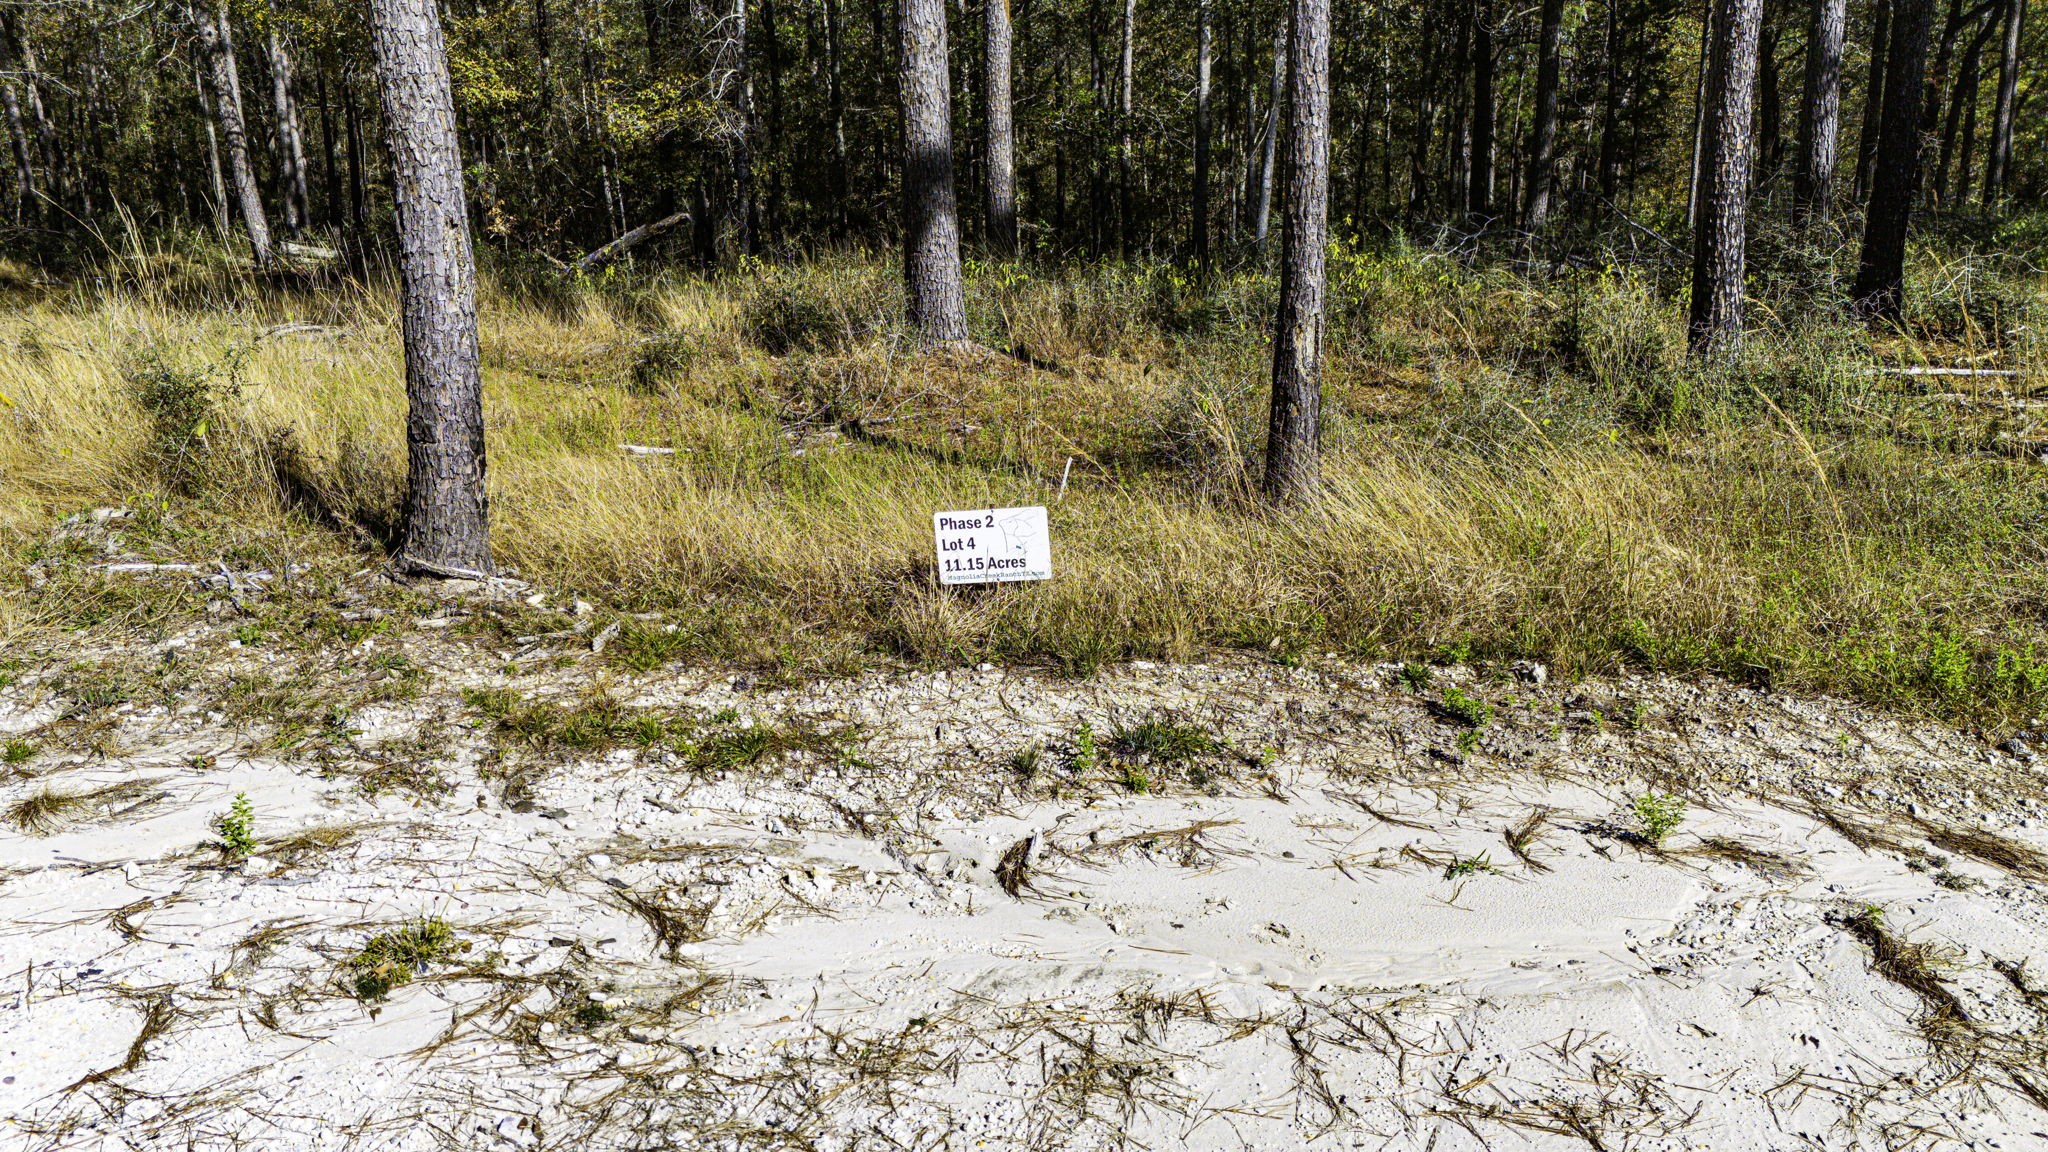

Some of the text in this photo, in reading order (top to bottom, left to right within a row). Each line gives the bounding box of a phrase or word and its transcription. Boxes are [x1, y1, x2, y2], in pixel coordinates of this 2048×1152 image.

[940, 515, 994, 530] Phase 2
[942, 537, 976, 551] Lot 4
[945, 557, 1026, 572] 11.15 Acres
